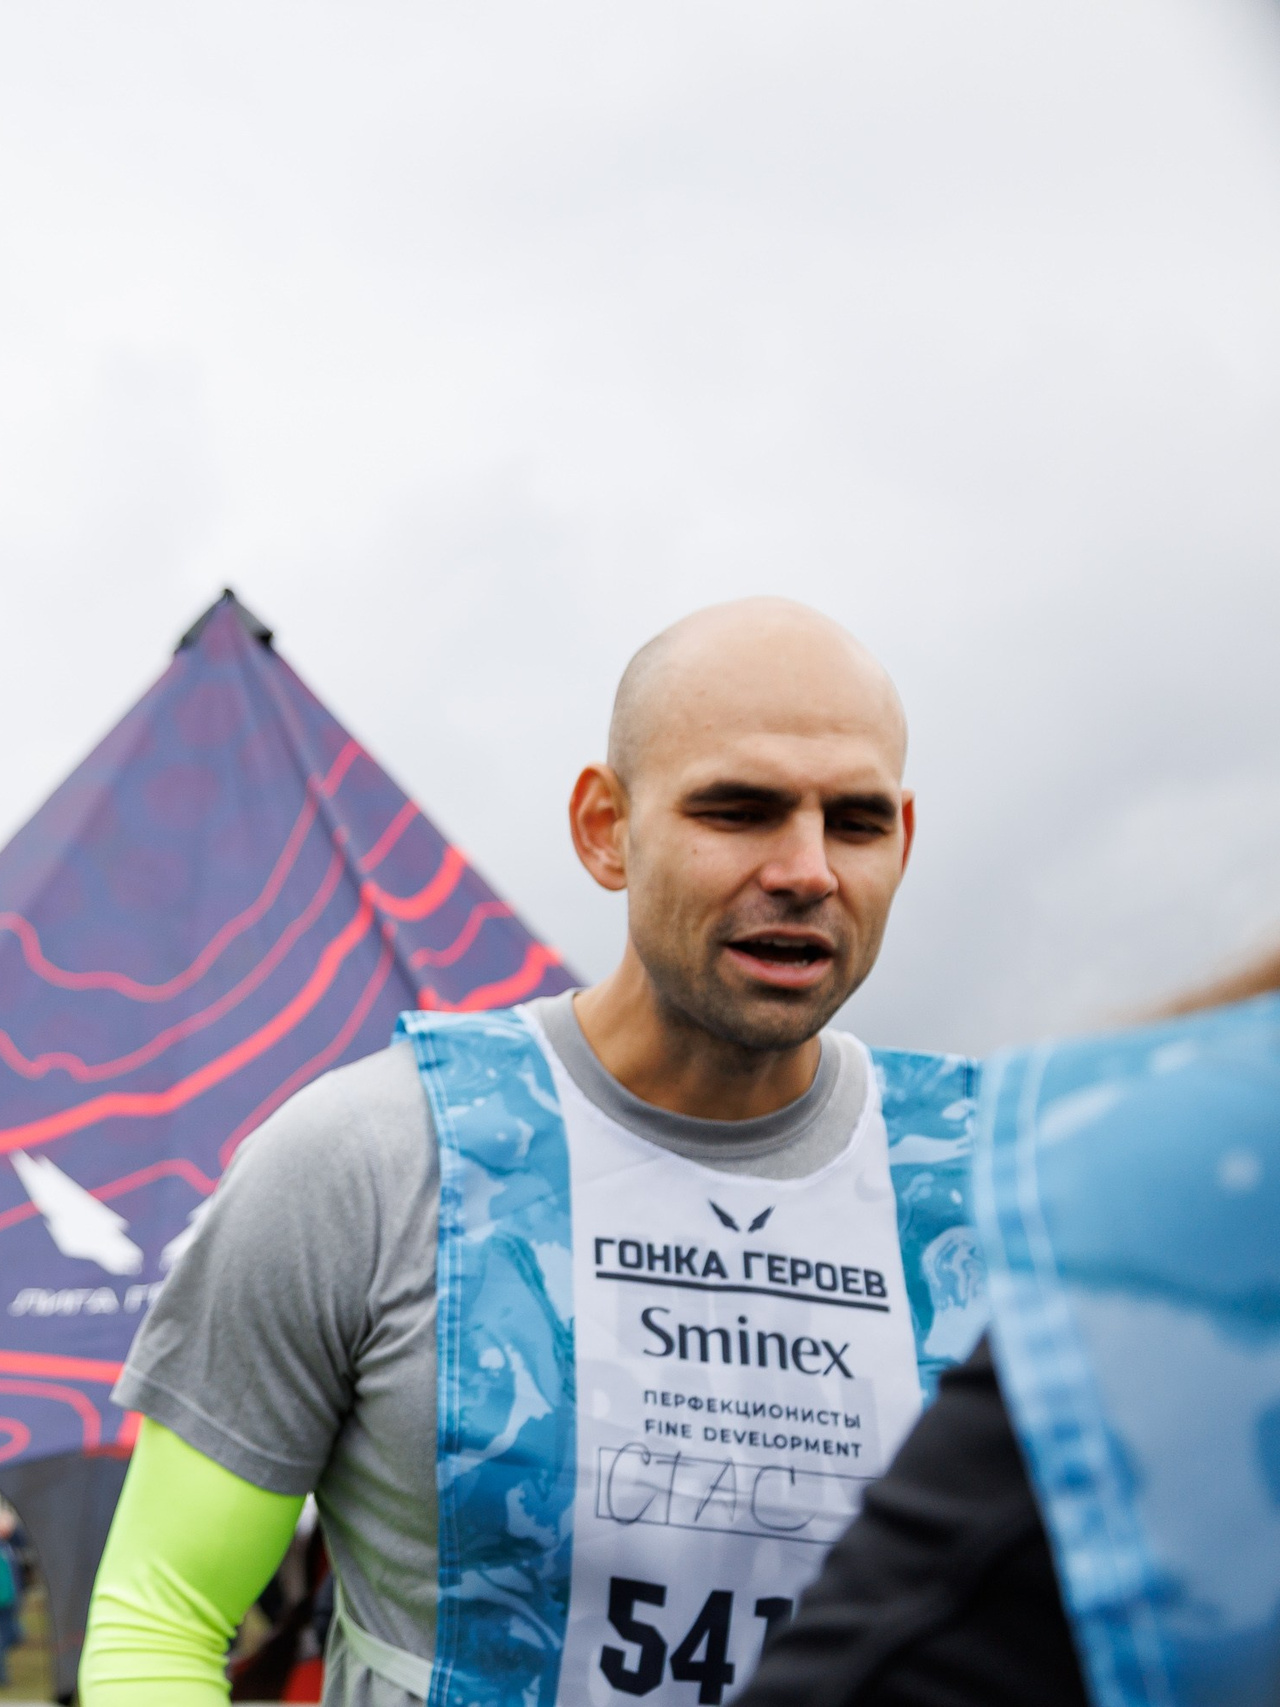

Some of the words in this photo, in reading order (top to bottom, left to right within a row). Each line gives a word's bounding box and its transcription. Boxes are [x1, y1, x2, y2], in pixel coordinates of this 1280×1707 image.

[594, 1237, 728, 1280] ГОНКА
[742, 1250, 888, 1299] ГЕРОЕВ
[640, 1307, 855, 1379] Sminex
[643, 1389, 862, 1430] ПЕРФЕКЦИОНИСТЫ
[644, 1418, 693, 1439] FINE
[703, 1426, 863, 1459] DEVELOPMENT
